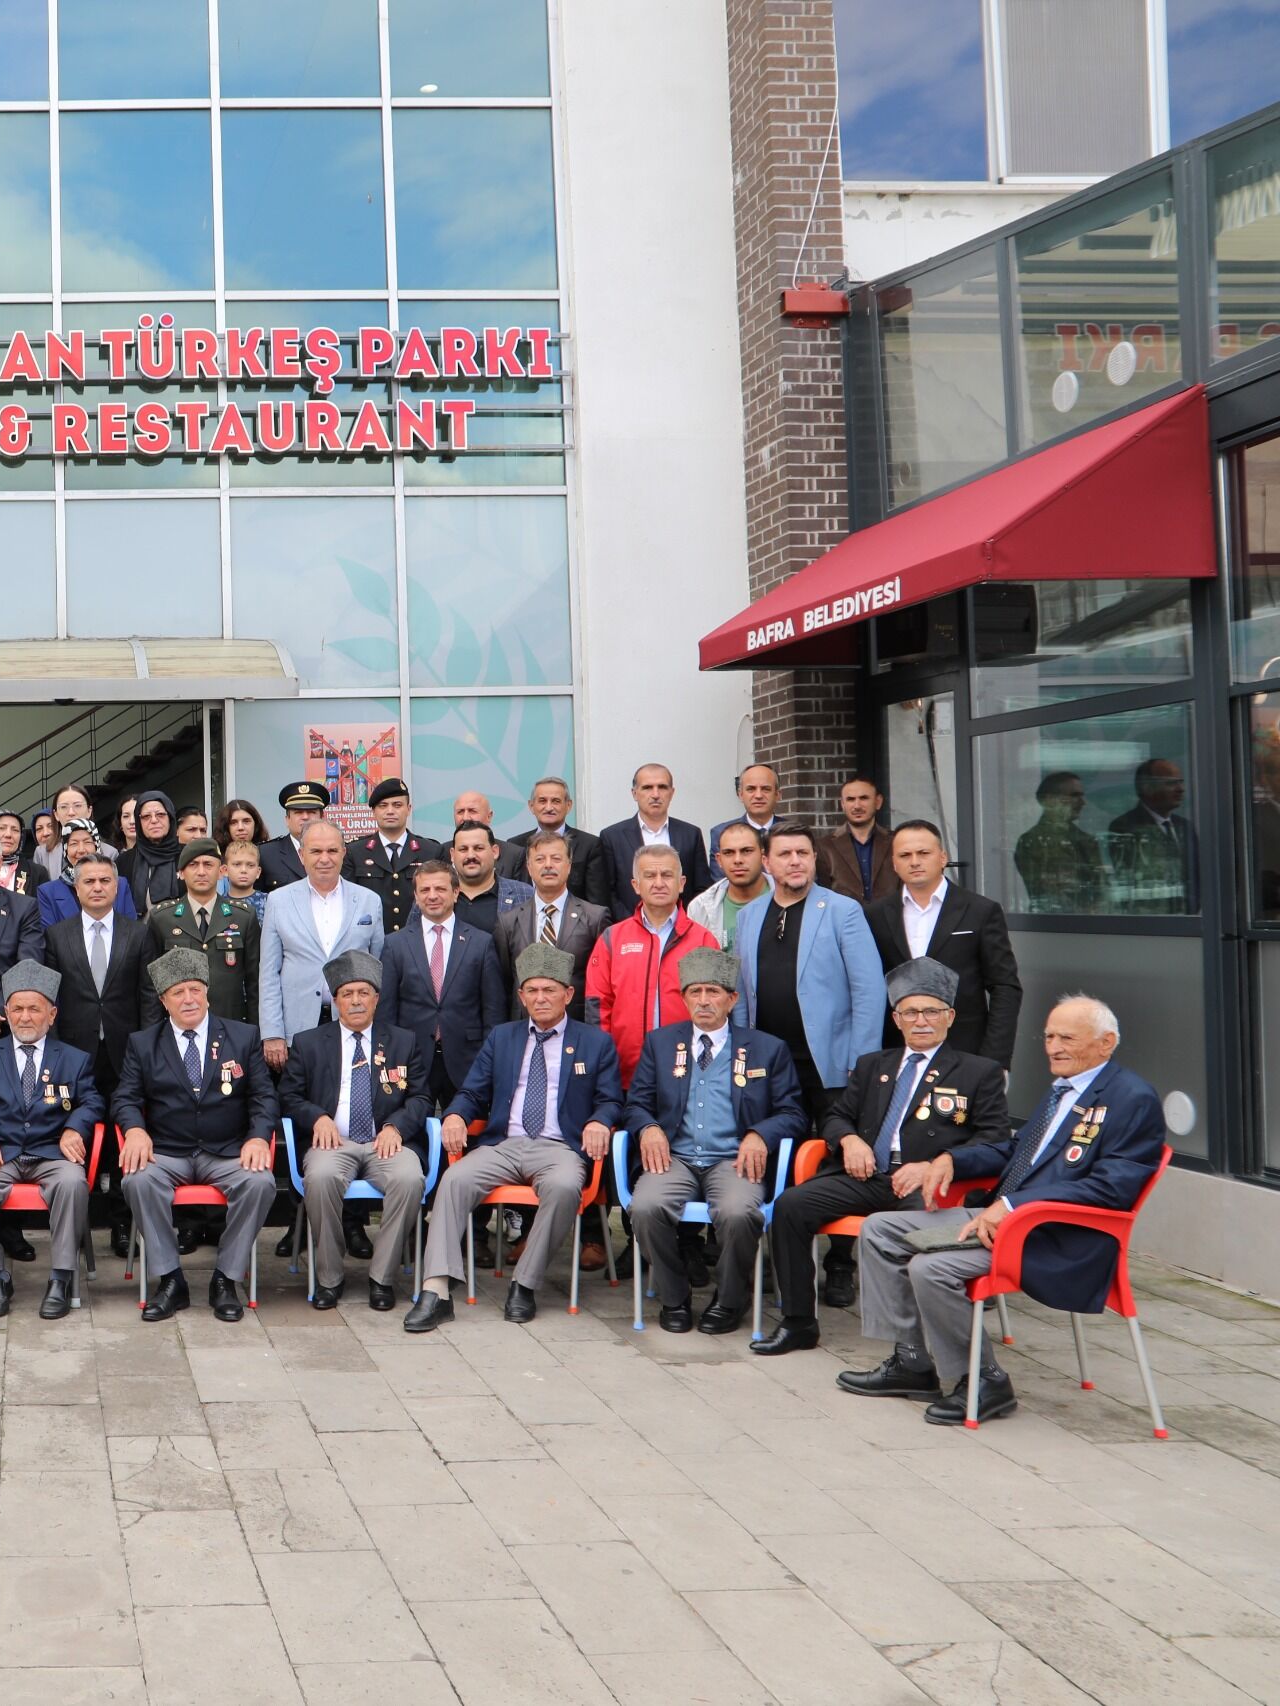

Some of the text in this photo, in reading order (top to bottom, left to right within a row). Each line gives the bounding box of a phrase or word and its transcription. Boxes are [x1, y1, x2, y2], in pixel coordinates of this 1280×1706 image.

[99, 312, 342, 394] TÜRKEŞ
[358, 326, 553, 378] PARKI
[51, 399, 476, 454] RESTAURANT
[747, 576, 902, 651] BAFRA BELEDİYESİ
